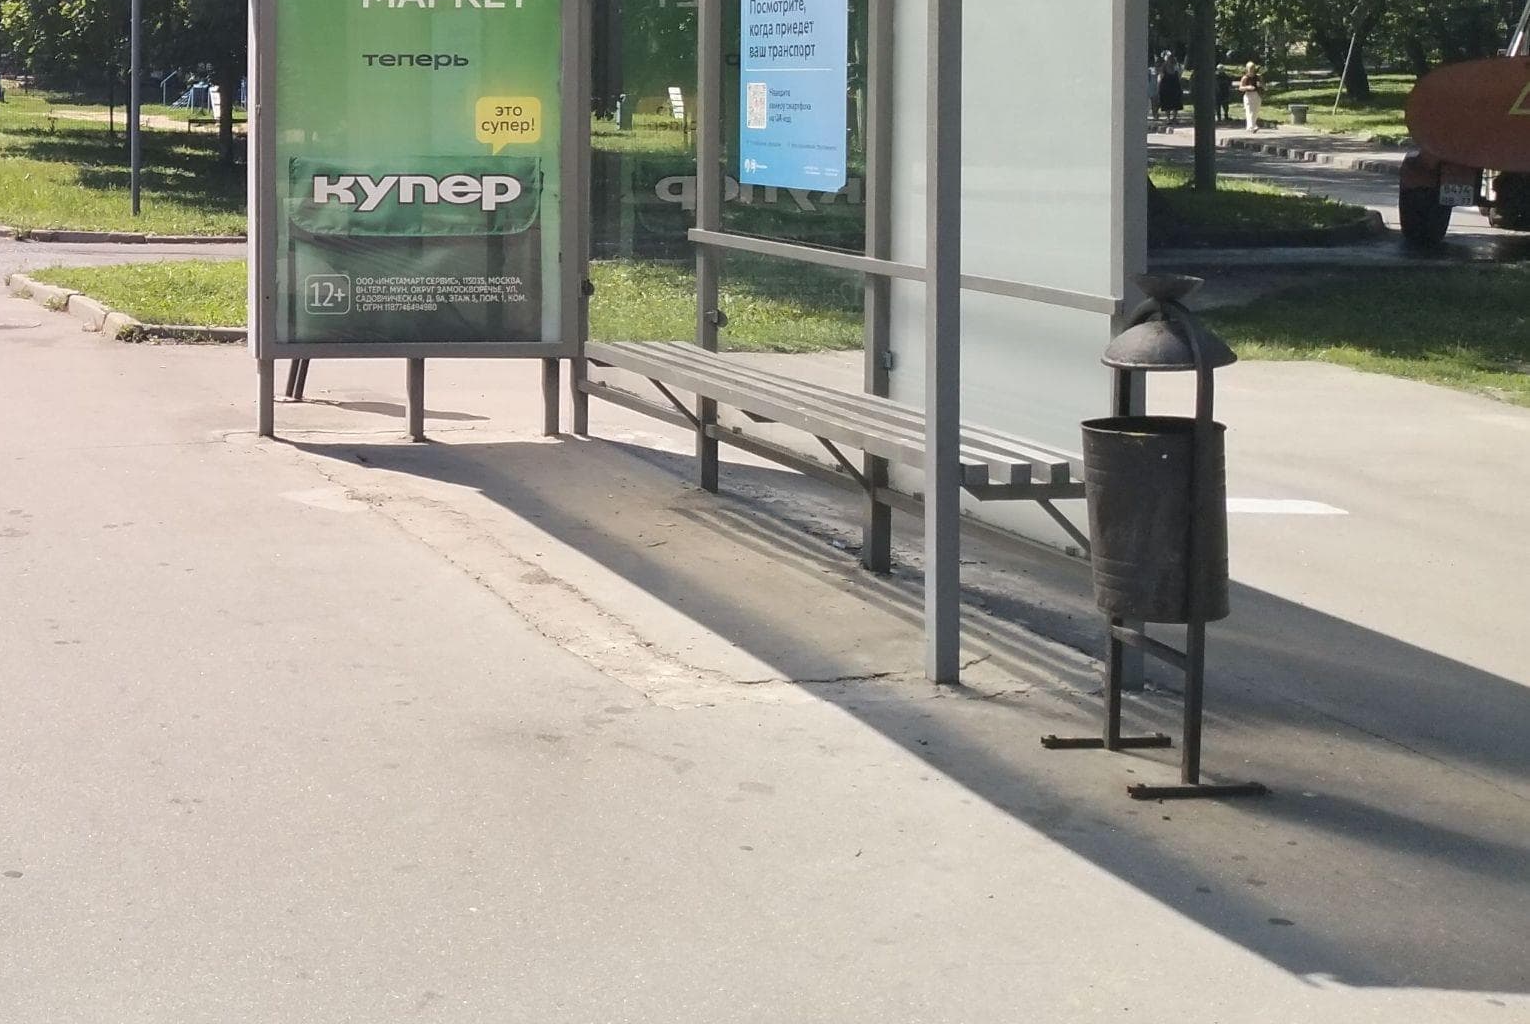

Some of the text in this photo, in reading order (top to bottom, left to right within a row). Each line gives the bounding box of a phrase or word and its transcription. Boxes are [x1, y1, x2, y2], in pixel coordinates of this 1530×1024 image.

[749, 21, 815, 38] когда приедет
[749, 44, 816, 61] ваш транспорт
[362, 53, 469, 71] теперь
[494, 105, 523, 117] это
[481, 117, 535, 135] супер!
[312, 173, 522, 212] купер
[355, 277, 374, 285] ООО
[488, 277, 523, 285] МОСКВА,
[310, 282, 346, 307] 12+
[410, 286, 435, 294] ОКРУГ
